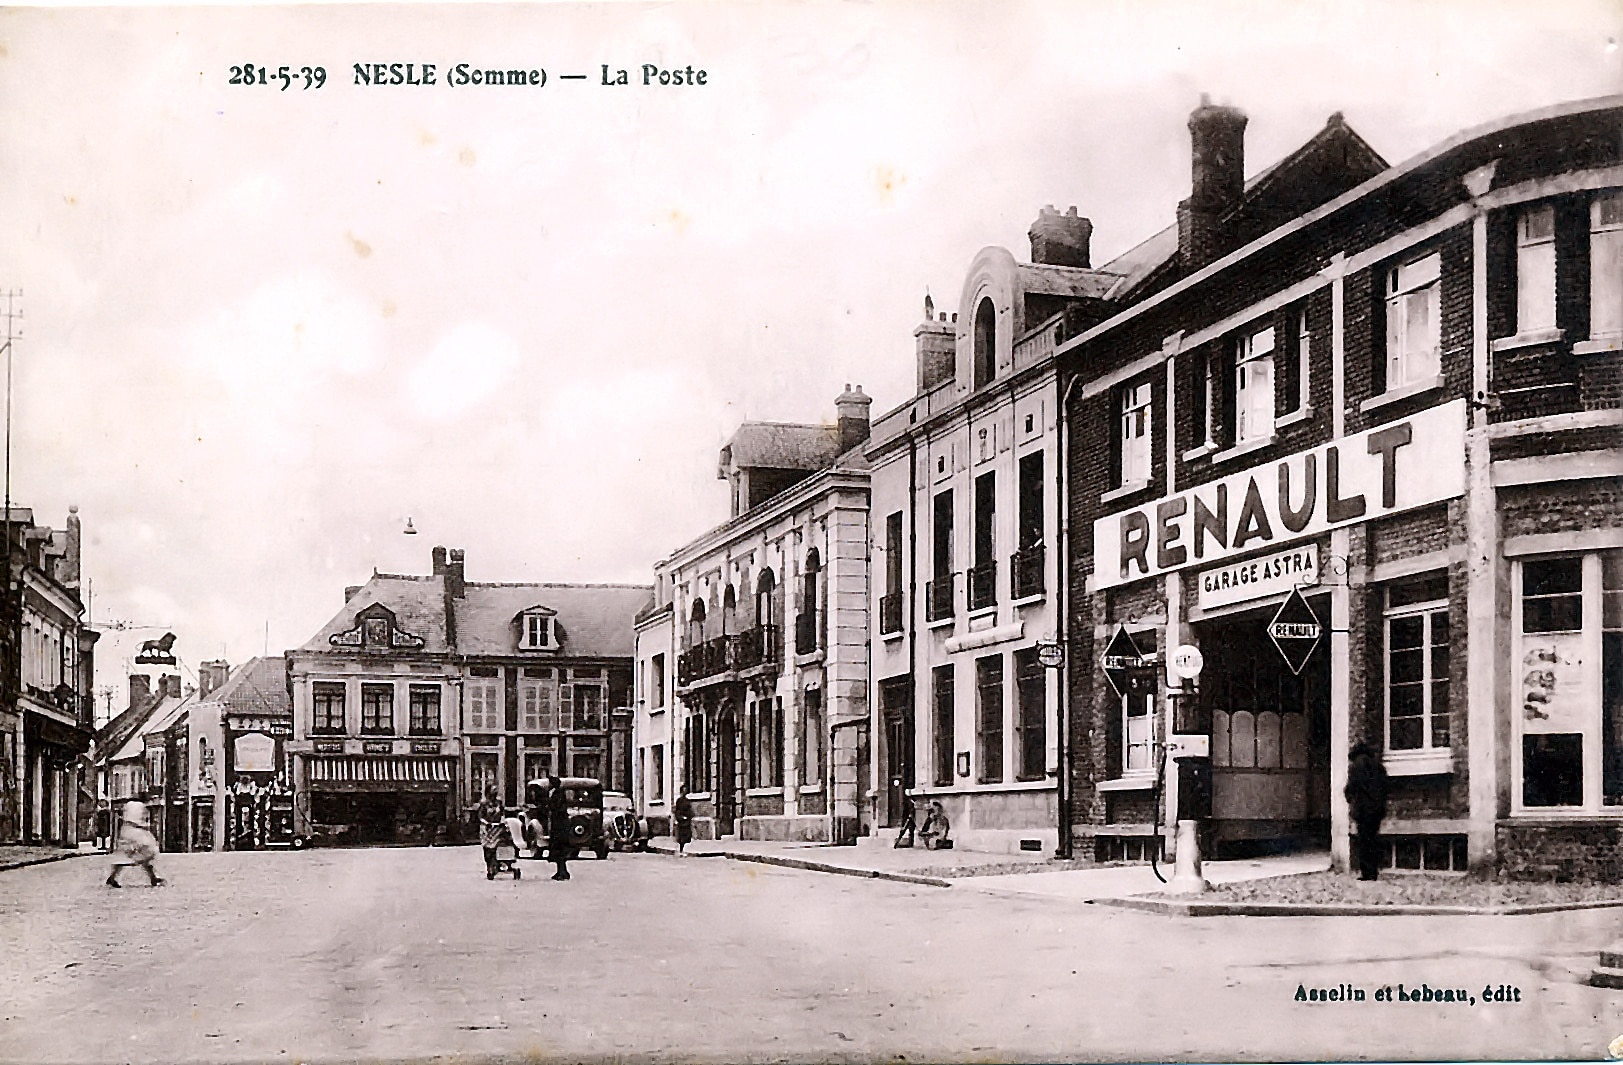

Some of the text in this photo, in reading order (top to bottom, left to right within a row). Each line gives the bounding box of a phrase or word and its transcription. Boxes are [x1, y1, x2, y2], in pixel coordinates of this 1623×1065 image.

[1119, 421, 1413, 579] RENAULT
[1204, 552, 1313, 593] GARAGE ASTRA
[1275, 624, 1317, 637] RENAULT
